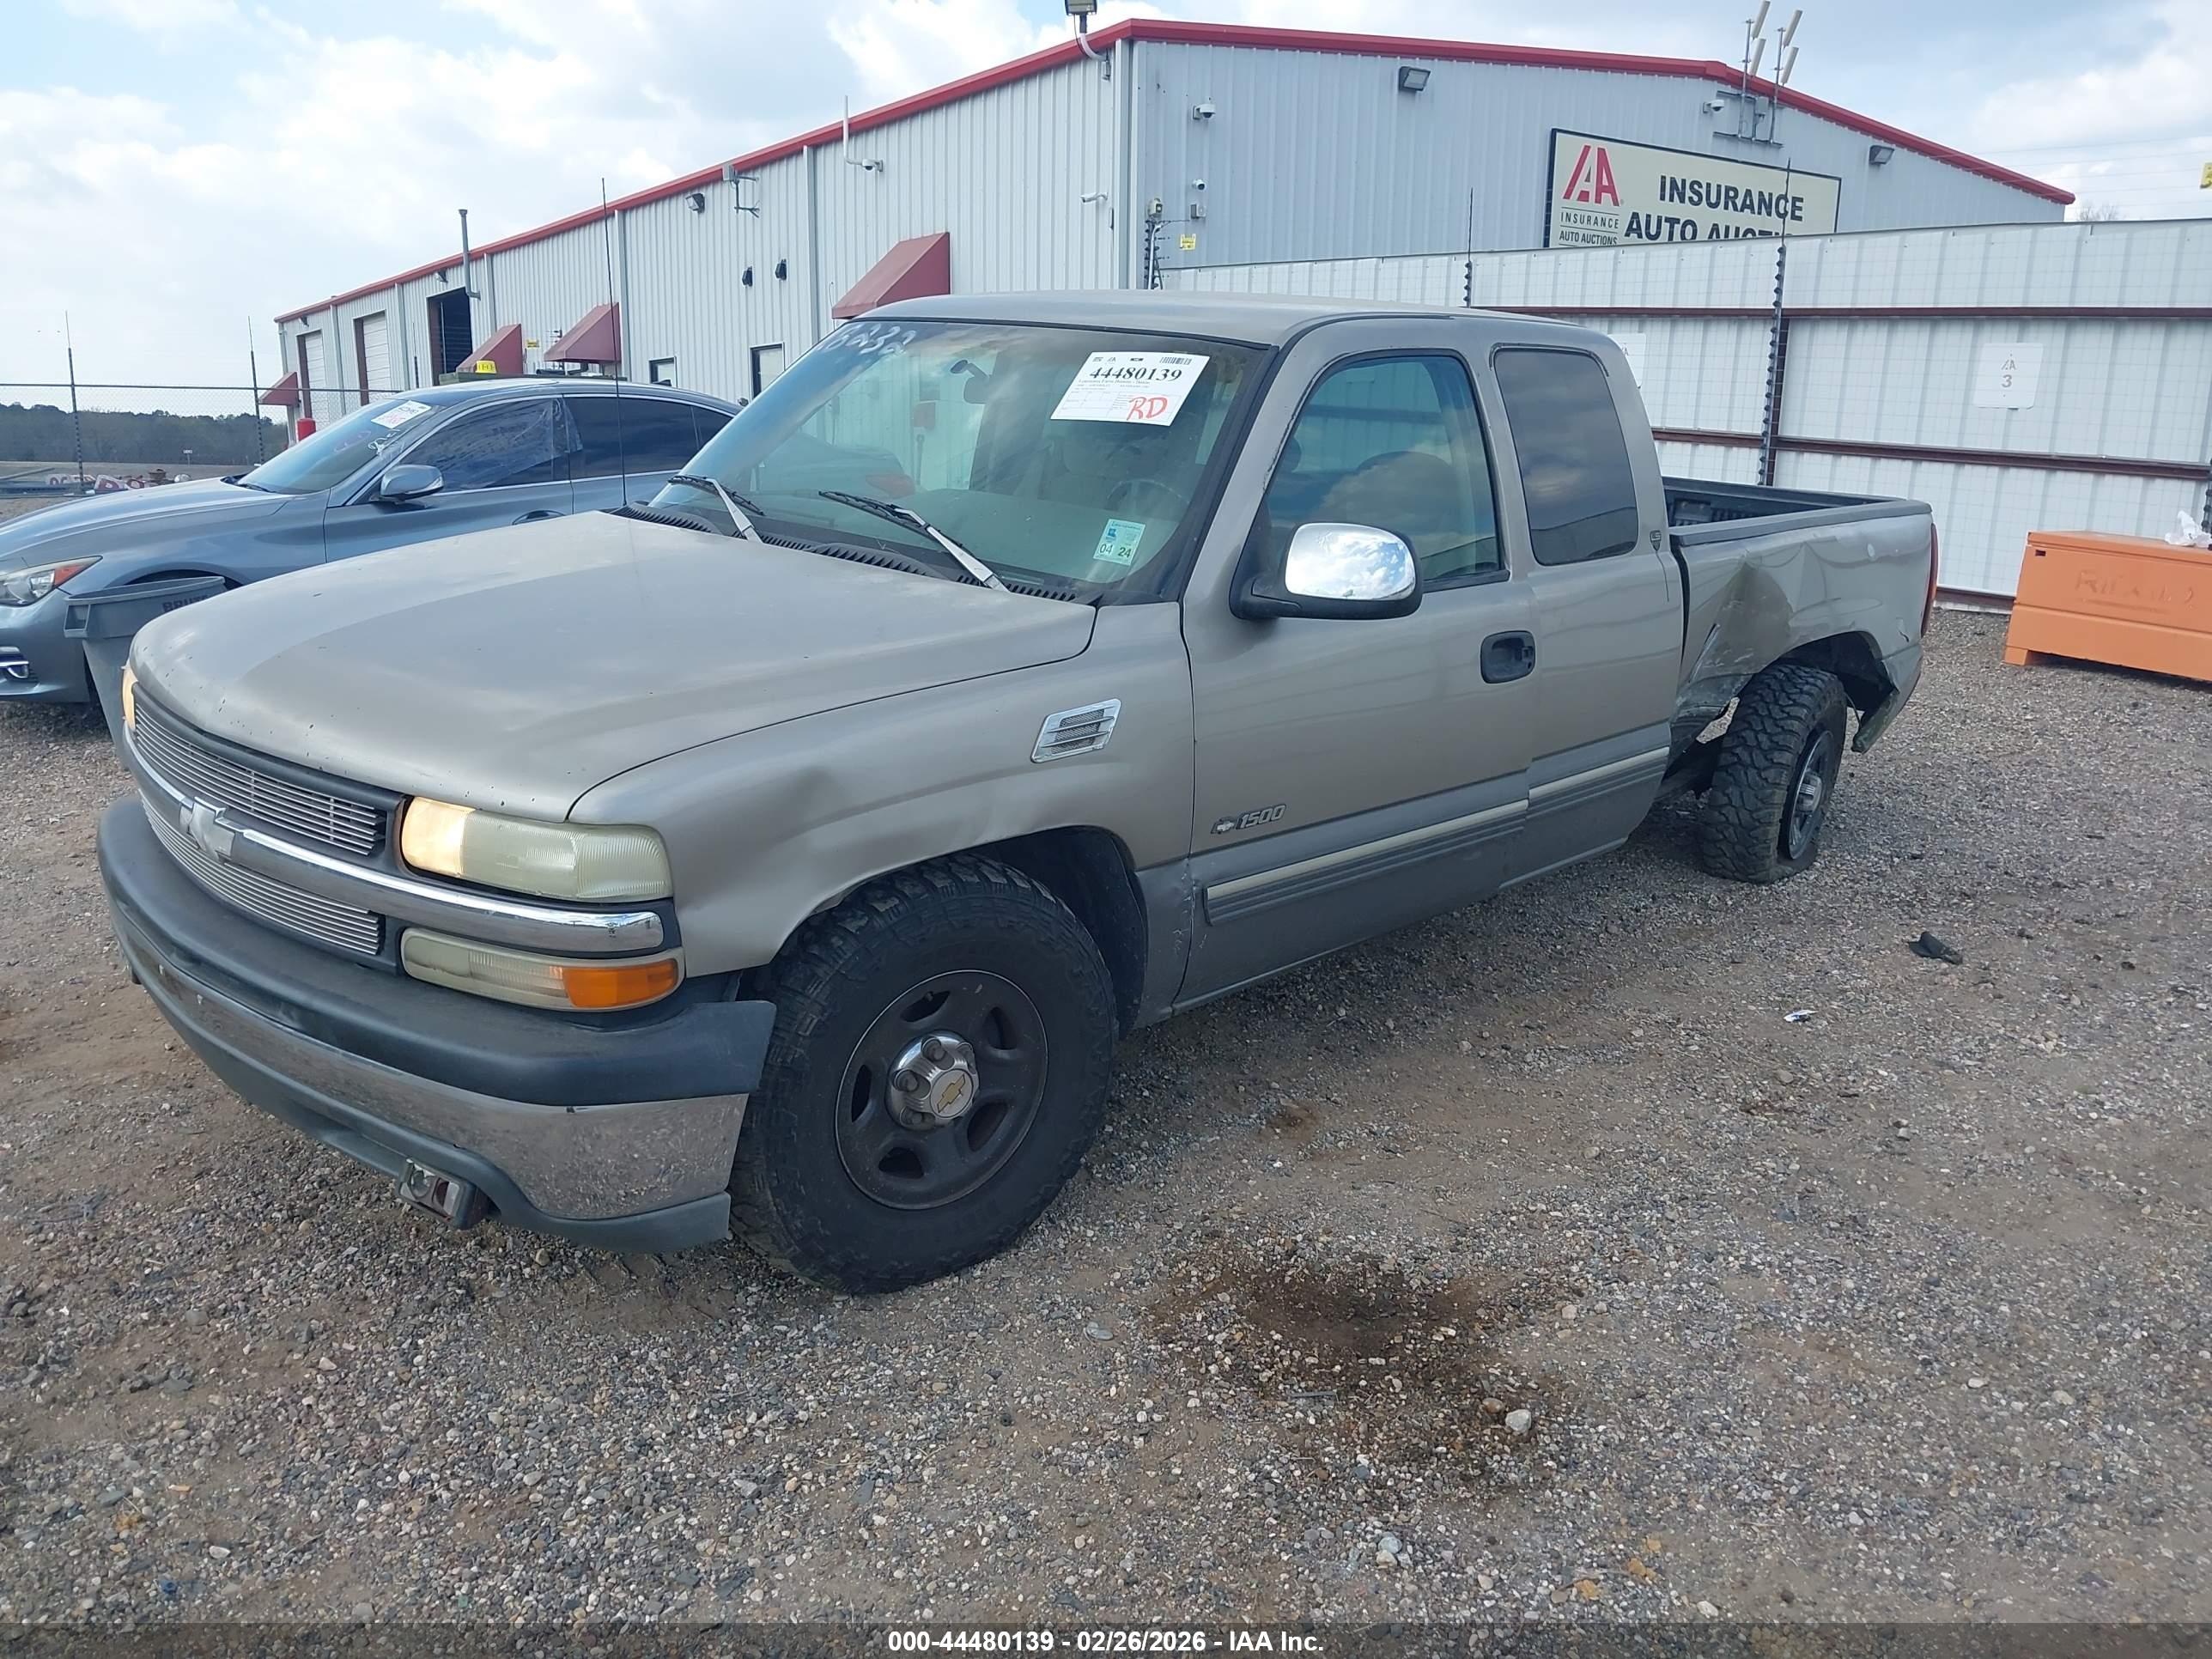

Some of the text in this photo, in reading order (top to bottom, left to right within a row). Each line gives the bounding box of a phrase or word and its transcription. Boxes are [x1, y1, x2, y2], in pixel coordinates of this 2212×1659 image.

[1659, 175, 1804, 222] INSURANCE
[1560, 211, 1619, 229] INSURANCE
[1624, 211, 1698, 242] AUTO
[1559, 230, 1618, 246] AUTO AUCTIONS
[1090, 367, 1182, 382] 44480139
[2002, 374, 2013, 388] 3
[1127, 396, 1168, 421] RD
[1099, 544, 1131, 558] 04 24
[1240, 805, 1286, 829] 1500
